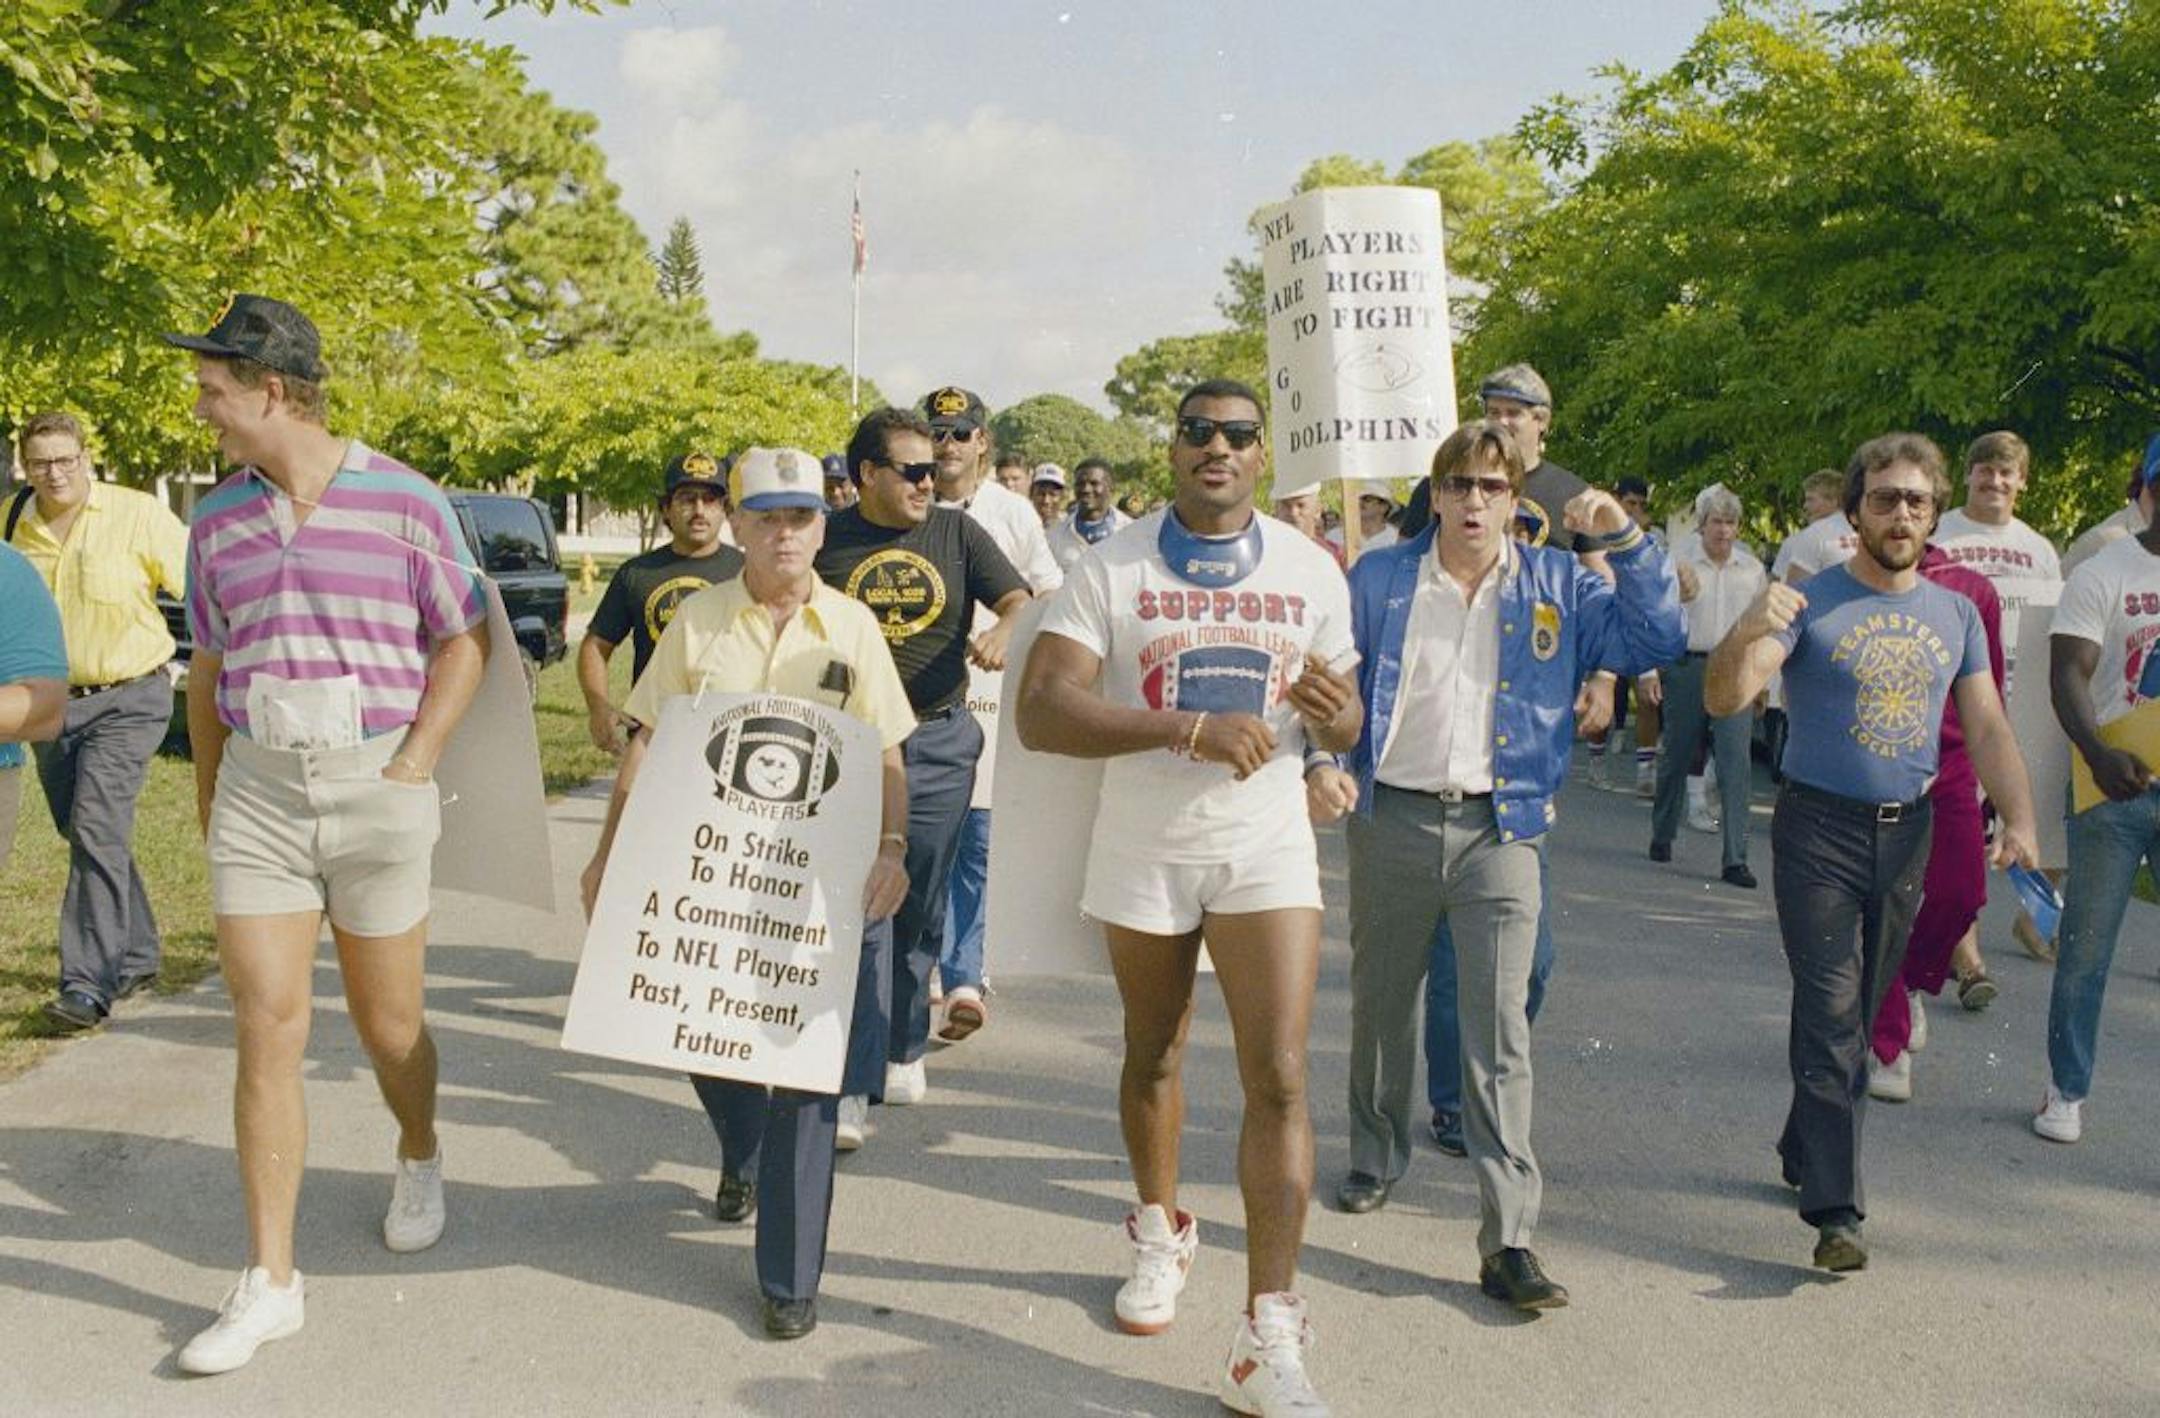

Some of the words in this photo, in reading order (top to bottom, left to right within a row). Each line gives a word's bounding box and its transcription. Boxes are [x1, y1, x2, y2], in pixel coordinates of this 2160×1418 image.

[1264, 213, 1294, 246] NFL
[1290, 230, 1424, 264] PLAYERS
[1270, 279, 1305, 315] ARE
[1326, 270, 1431, 293] RIGHT
[1292, 313, 1318, 342] TO
[1333, 306, 1434, 330] FIGHT
[1290, 416, 1441, 454] DOLPHINS
[1951, 547, 2032, 569] SUPPORT
[1137, 590, 1306, 627] SUPPORT
[1138, 627, 1192, 673] NATIONAL
[1197, 625, 1260, 645] FOOTBALL
[1831, 613, 1951, 665] TEAMSTERS
[1849, 724, 1898, 758] LOCAL
[727, 789, 805, 821] PLAYERS
[693, 823, 728, 854] On
[744, 832, 810, 869] Strike
[690, 855, 714, 884] To
[729, 867, 804, 900] Honor
[643, 891, 659, 919] A
[674, 895, 827, 947] Commitment
[636, 931, 660, 960] To
[673, 936, 719, 970] NFL
[734, 949, 820, 988] Players
[628, 973, 689, 1014] Past,
[708, 987, 805, 1033] Present,
[673, 1023, 753, 1062] Future
